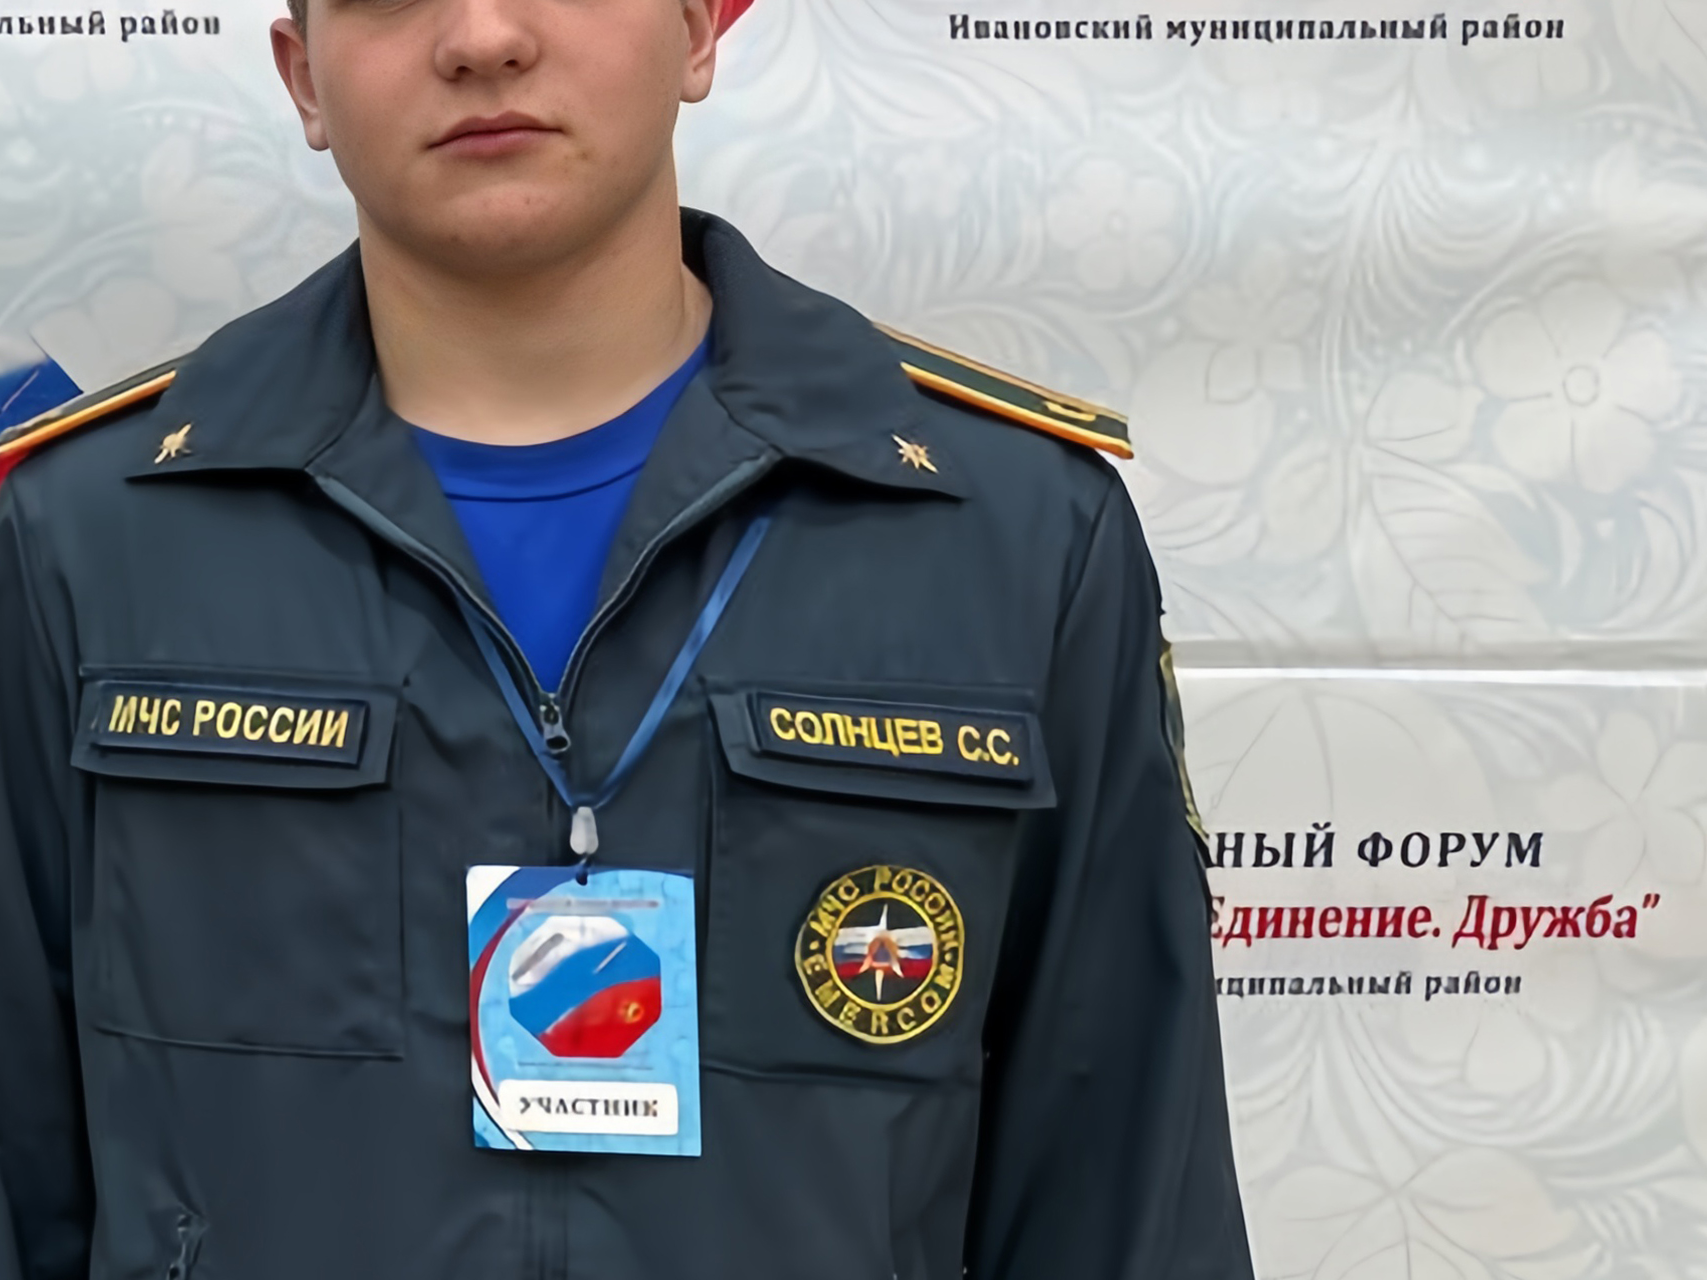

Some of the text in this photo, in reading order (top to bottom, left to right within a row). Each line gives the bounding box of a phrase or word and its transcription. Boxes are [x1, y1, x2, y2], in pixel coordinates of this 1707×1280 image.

[120, 10, 219, 42] район
[1167, 13, 1446, 46] муниципальный
[1462, 14, 1563, 46] район
[108, 694, 349, 749] МЧС РОССИИ
[770, 707, 1020, 766] СОЛНЦЕВ С.С.
[1207, 821, 1543, 868] НЫЙ ФОРУМ
[1425, 971, 1521, 1001] район
[518, 1096, 659, 1118] УЧАСТНИК
